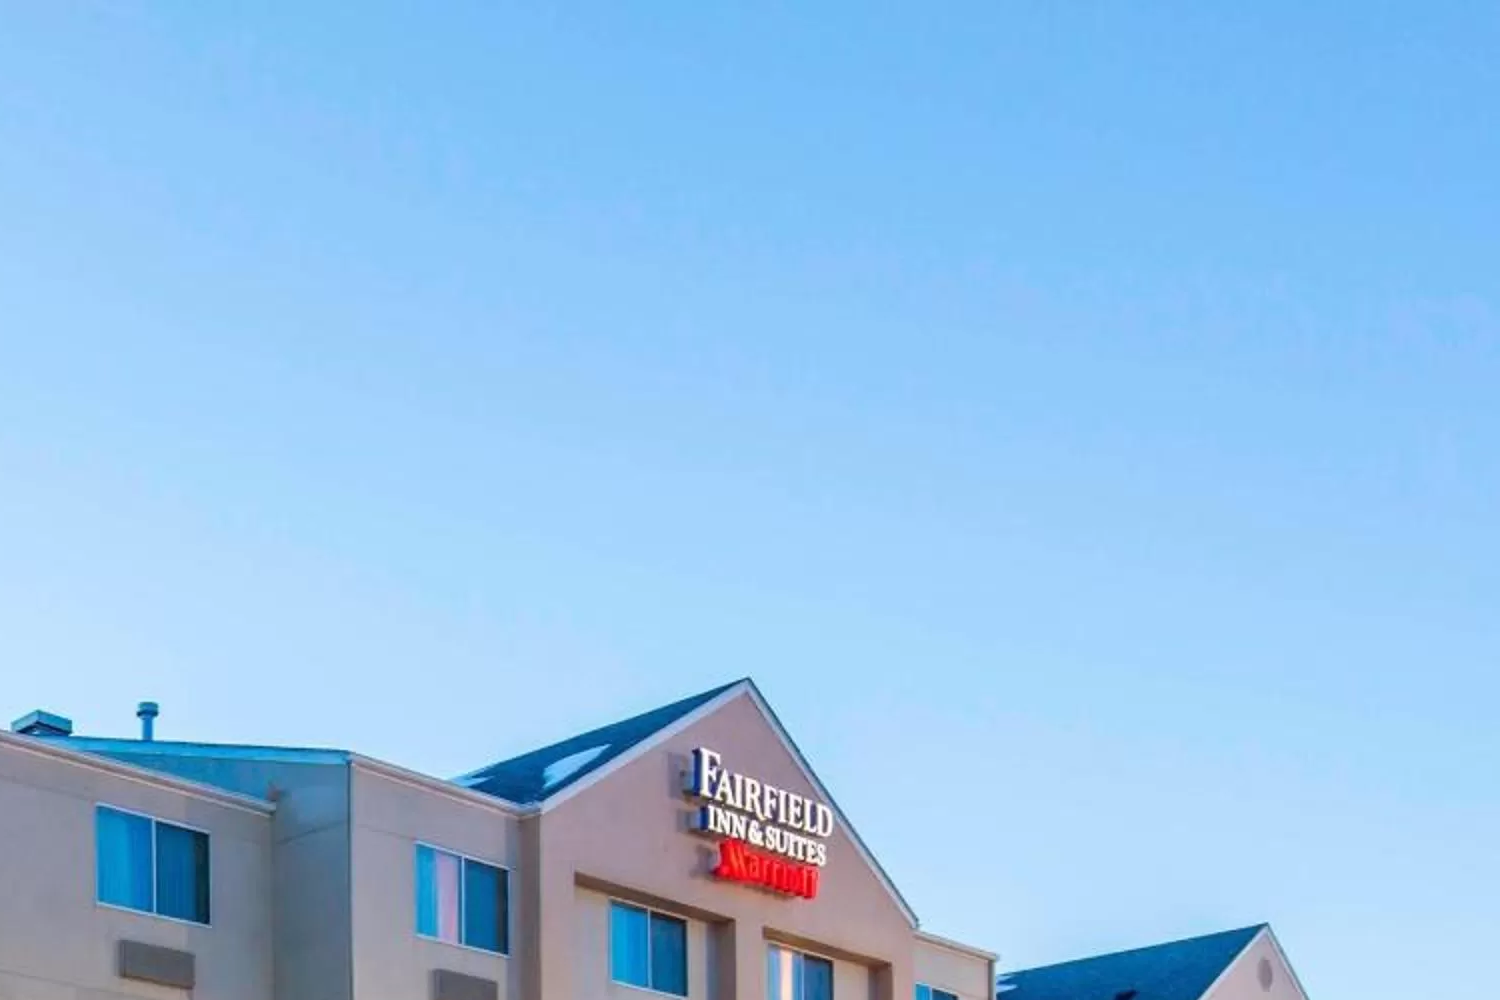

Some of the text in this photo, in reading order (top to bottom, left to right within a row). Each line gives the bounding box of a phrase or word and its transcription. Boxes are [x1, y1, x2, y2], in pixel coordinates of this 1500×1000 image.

[698, 747, 834, 837] FAIRFIELD
[707, 804, 747, 840] INN
[765, 825, 827, 866] SUITES
[718, 838, 820, 899] Marriott
